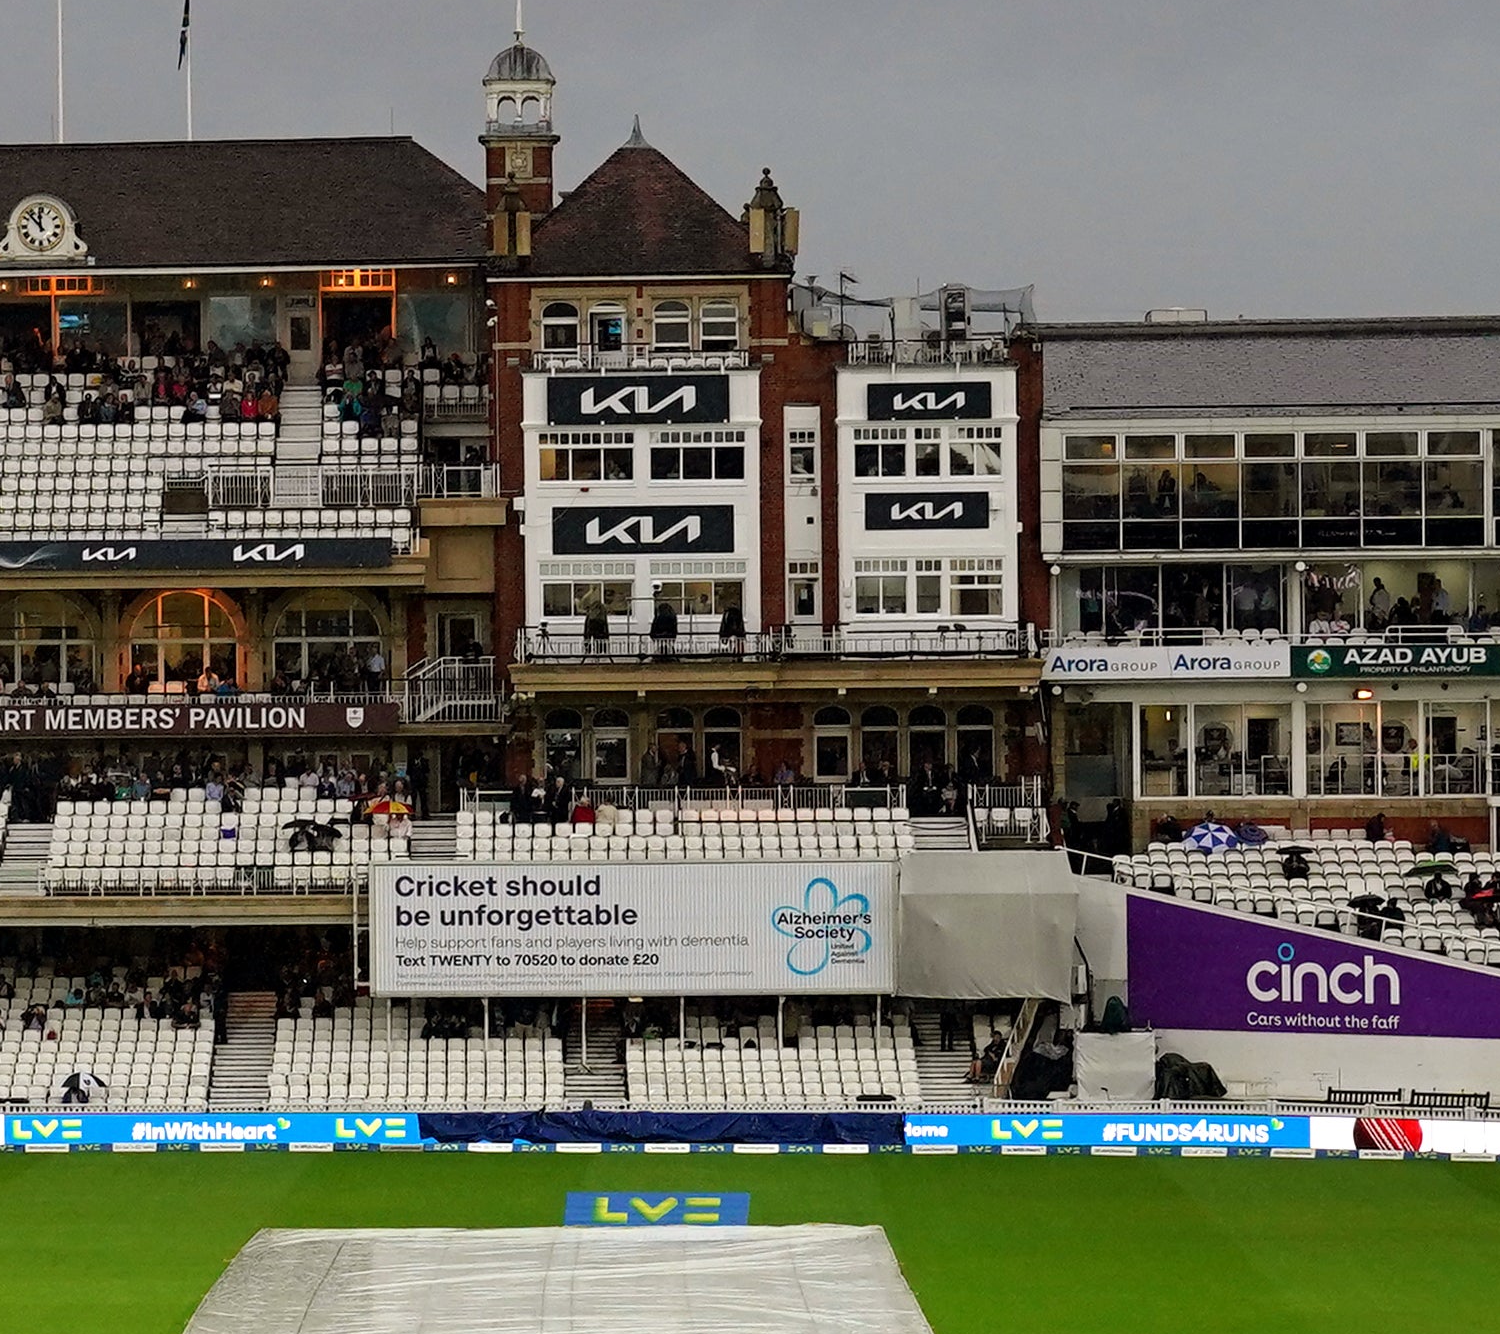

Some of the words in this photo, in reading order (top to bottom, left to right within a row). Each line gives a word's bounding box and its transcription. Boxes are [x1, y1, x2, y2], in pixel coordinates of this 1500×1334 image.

[1051, 655, 1108, 673] Arora
[1110, 662, 1158, 672] GROUP
[1173, 654, 1232, 671] Arora
[1233, 661, 1281, 671] GROUP
[1343, 647, 1413, 665] AZAD
[1419, 647, 1487, 664] AYUB
[1359, 666, 1402, 674] PROPERTY
[1410, 665, 1471, 673] PHILANTHROPY
[189, 707, 307, 730] PAVILION
[395, 875, 498, 897] Cricket
[505, 874, 601, 897] should
[395, 904, 431, 927] be
[440, 904, 638, 931] unforgettable
[395, 936, 428, 951] Help
[431, 937, 487, 951] support
[490, 935, 522, 949] fans
[524, 935, 552, 948] and
[555, 935, 606, 950] players
[609, 935, 645, 950] living
[647, 934, 678, 947] with
[680, 934, 750, 947] dementia
[794, 925, 856, 942] Society
[396, 955, 427, 967] Text
[430, 955, 493, 967] TWENTY
[495, 955, 511, 967] to
[514, 955, 558, 967] 70520
[561, 955, 576, 966] to
[579, 954, 630, 966] donate
[632, 954, 660, 966] £20
[1246, 943, 1401, 1006] cinch
[1247, 1011, 1282, 1027] Cars
[1284, 1012, 1340, 1029] without
[1344, 1013, 1369, 1028] the
[1371, 1012, 1400, 1030] faff
[131, 1120, 277, 1143] #InWithHeart
[1102, 1120, 1270, 1144] #FUNDS4RUNS
